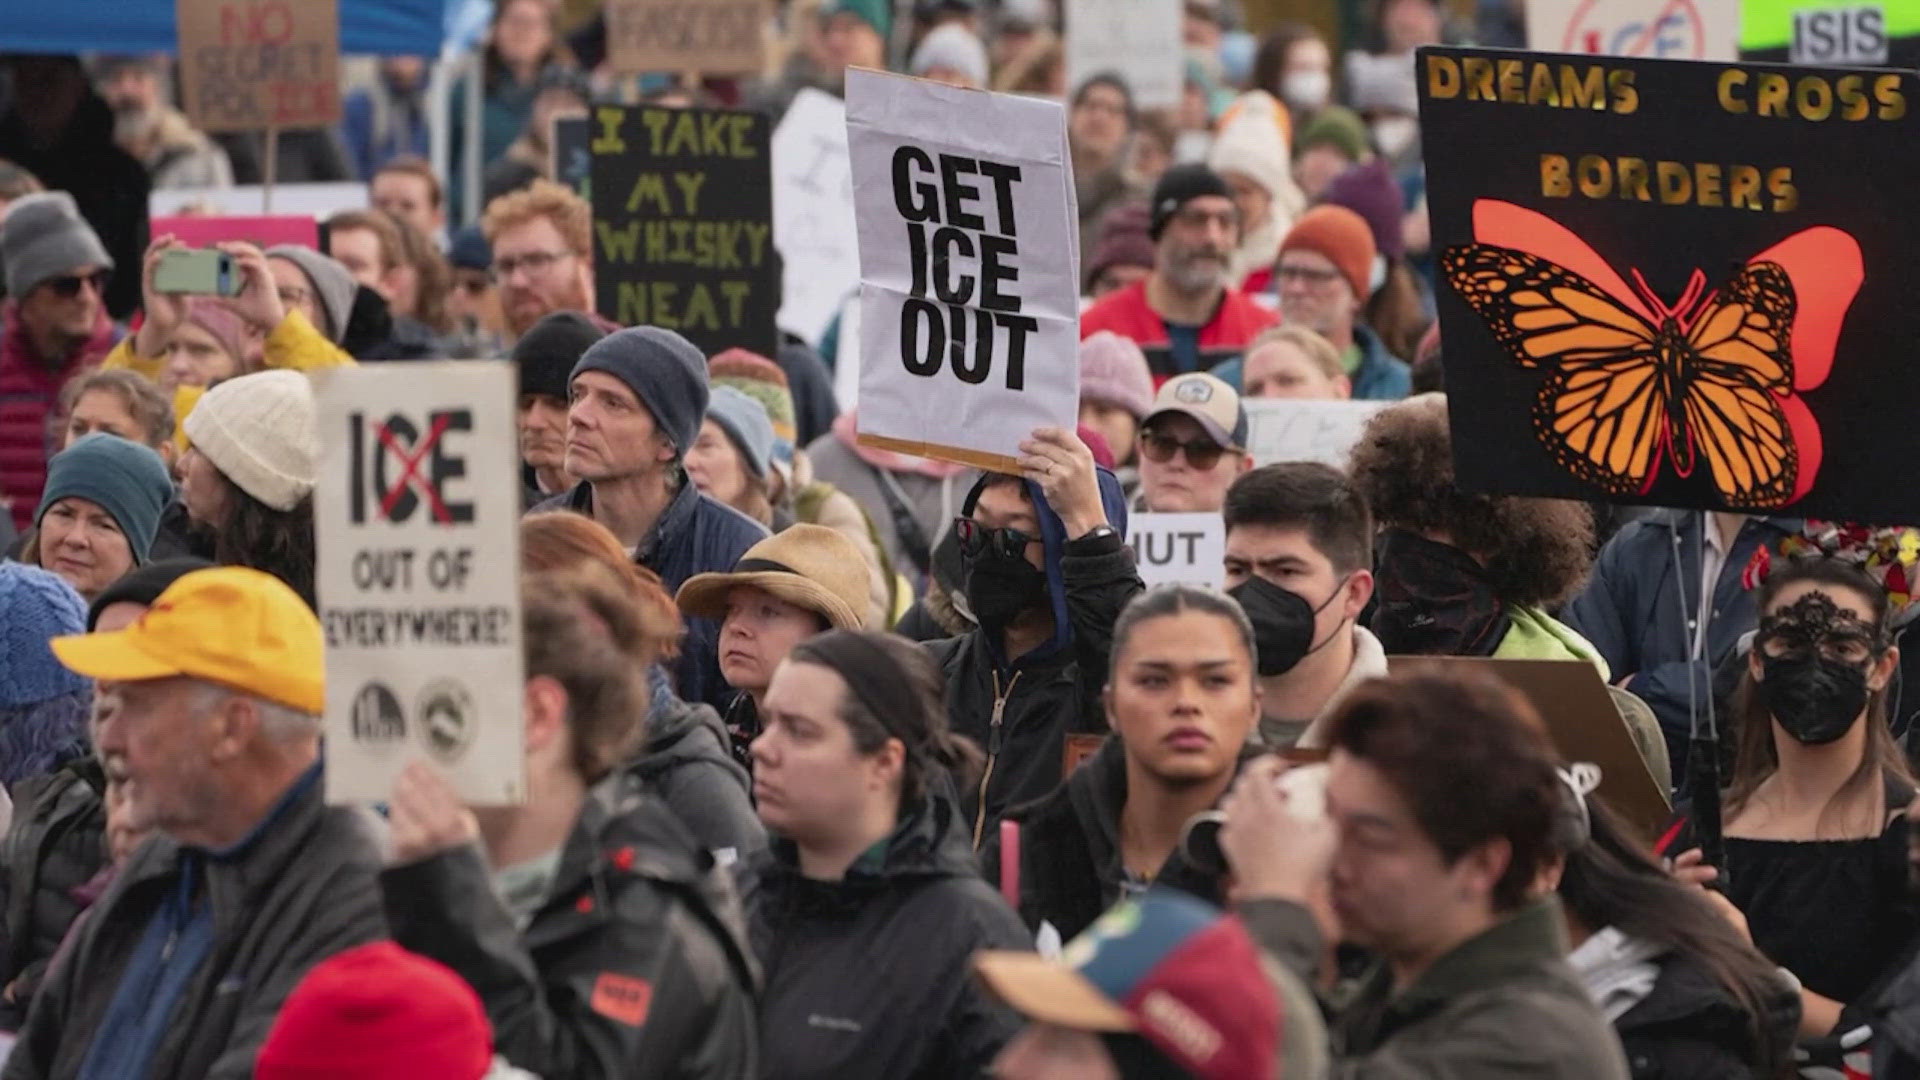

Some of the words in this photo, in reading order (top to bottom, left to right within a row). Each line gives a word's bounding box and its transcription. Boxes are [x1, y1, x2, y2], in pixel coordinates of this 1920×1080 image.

[219, 3, 295, 45] NO
[1794, 7, 1884, 59] ISIS
[1427, 54, 1640, 115] DREAMS
[1717, 68, 1907, 122] CROSS
[592, 107, 626, 155] I
[642, 109, 758, 158] TAKE
[625, 171, 706, 214] MY
[892, 145, 1022, 237] GET
[1540, 153, 1799, 213] BORDERS
[595, 218, 769, 269] WHISKY
[907, 222, 1022, 313] ICE
[616, 280, 750, 325] NEAT
[901, 298, 1039, 391] OUT
[349, 410, 475, 525] ICE
[352, 549, 413, 591] OUT
[428, 547, 472, 591] OF
